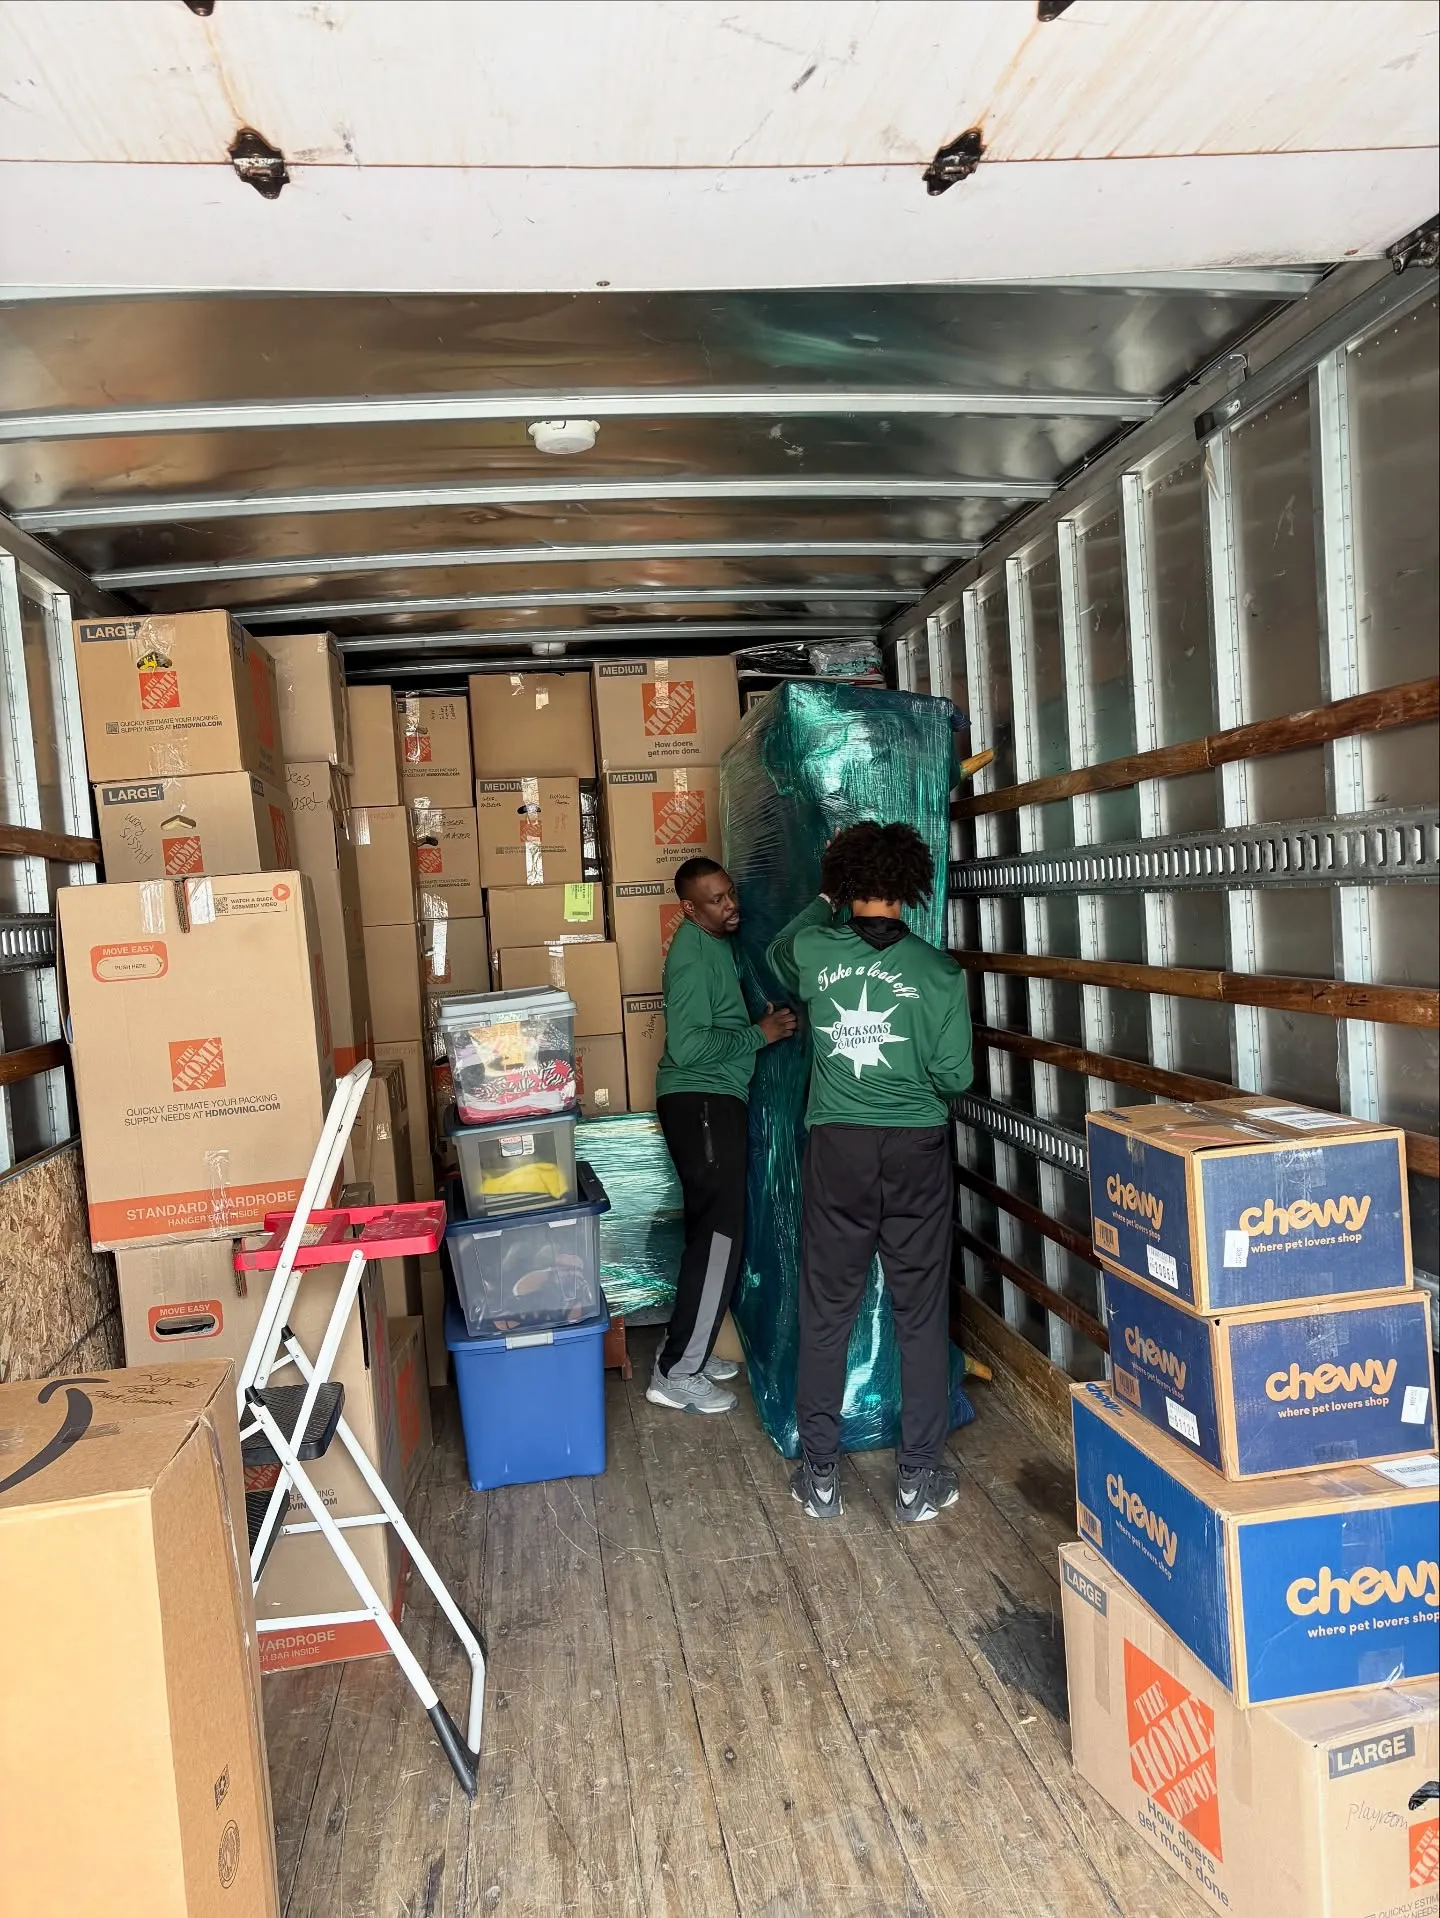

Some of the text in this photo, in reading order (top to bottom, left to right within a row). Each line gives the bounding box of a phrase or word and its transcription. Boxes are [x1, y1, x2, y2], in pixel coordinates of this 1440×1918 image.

[86, 625, 136, 639] LARGE
[602, 665, 644, 675] MEDIUM
[142, 671, 178, 710] HOME
[157, 685, 178, 709] DEPOT
[644, 682, 695, 736] HOME
[665, 700, 695, 735] DEPOT
[647, 749, 660, 757] get
[484, 782, 523, 791] MEDIUM
[612, 773, 654, 782] MEDIUM
[108, 787, 158, 802] LARGE
[654, 791, 706, 844] HOME
[675, 808, 706, 843] DEPOT
[165, 836, 201, 875] HOME
[168, 841, 183, 857] THE
[180, 850, 203, 875] DEPOT
[655, 855, 668, 864] get
[681, 846, 702, 854] doers
[619, 886, 661, 895] MEDIUM
[102, 944, 155, 956] MOVE EASY
[817, 963, 852, 992] Take
[855, 965, 866, 976] a
[867, 961, 902, 983] load
[631, 1003, 664, 1011] MEDIU
[172, 1037, 223, 1091] HOME
[175, 1044, 197, 1069] THE
[194, 1057, 225, 1090] DEPOT
[124, 1103, 281, 1127] SUPPLY NEEDS AT HDMOVING.COM
[126, 1093, 278, 1117] QUICKLY ESTIMATE YOUR PACKING
[126, 1190, 297, 1221] STANDARD WARDROBE
[1106, 1173, 1164, 1230] chewy
[167, 1214, 207, 1227] HANGER
[1239, 1194, 1372, 1237] chewy
[1251, 1232, 1362, 1253] where pet lovers shop
[159, 1303, 211, 1316] MOVE EASY
[1124, 1325, 1187, 1390] chewy
[1265, 1358, 1398, 1402] chewy
[1277, 1397, 1390, 1419] where pet lovers shop
[1106, 1473, 1178, 1567] chewy
[1066, 1566, 1102, 1608] LARGE
[1286, 1560, 1439, 1616] chewy
[1307, 1611, 1439, 1638] where pet lovers shop
[271, 1651, 290, 1661] BAR
[291, 1646, 320, 1657] INSIDE
[1133, 1680, 1168, 1726] THE
[1130, 1696, 1215, 1797] HOME
[1337, 1734, 1407, 1771] LARGE
[1164, 1761, 1218, 1822] DEPOT
[1137, 1810, 1158, 1837] get
[1160, 1830, 1193, 1870] more
[1147, 1797, 1216, 1874] How doers
[1415, 1893, 1439, 1908] ESTIM
